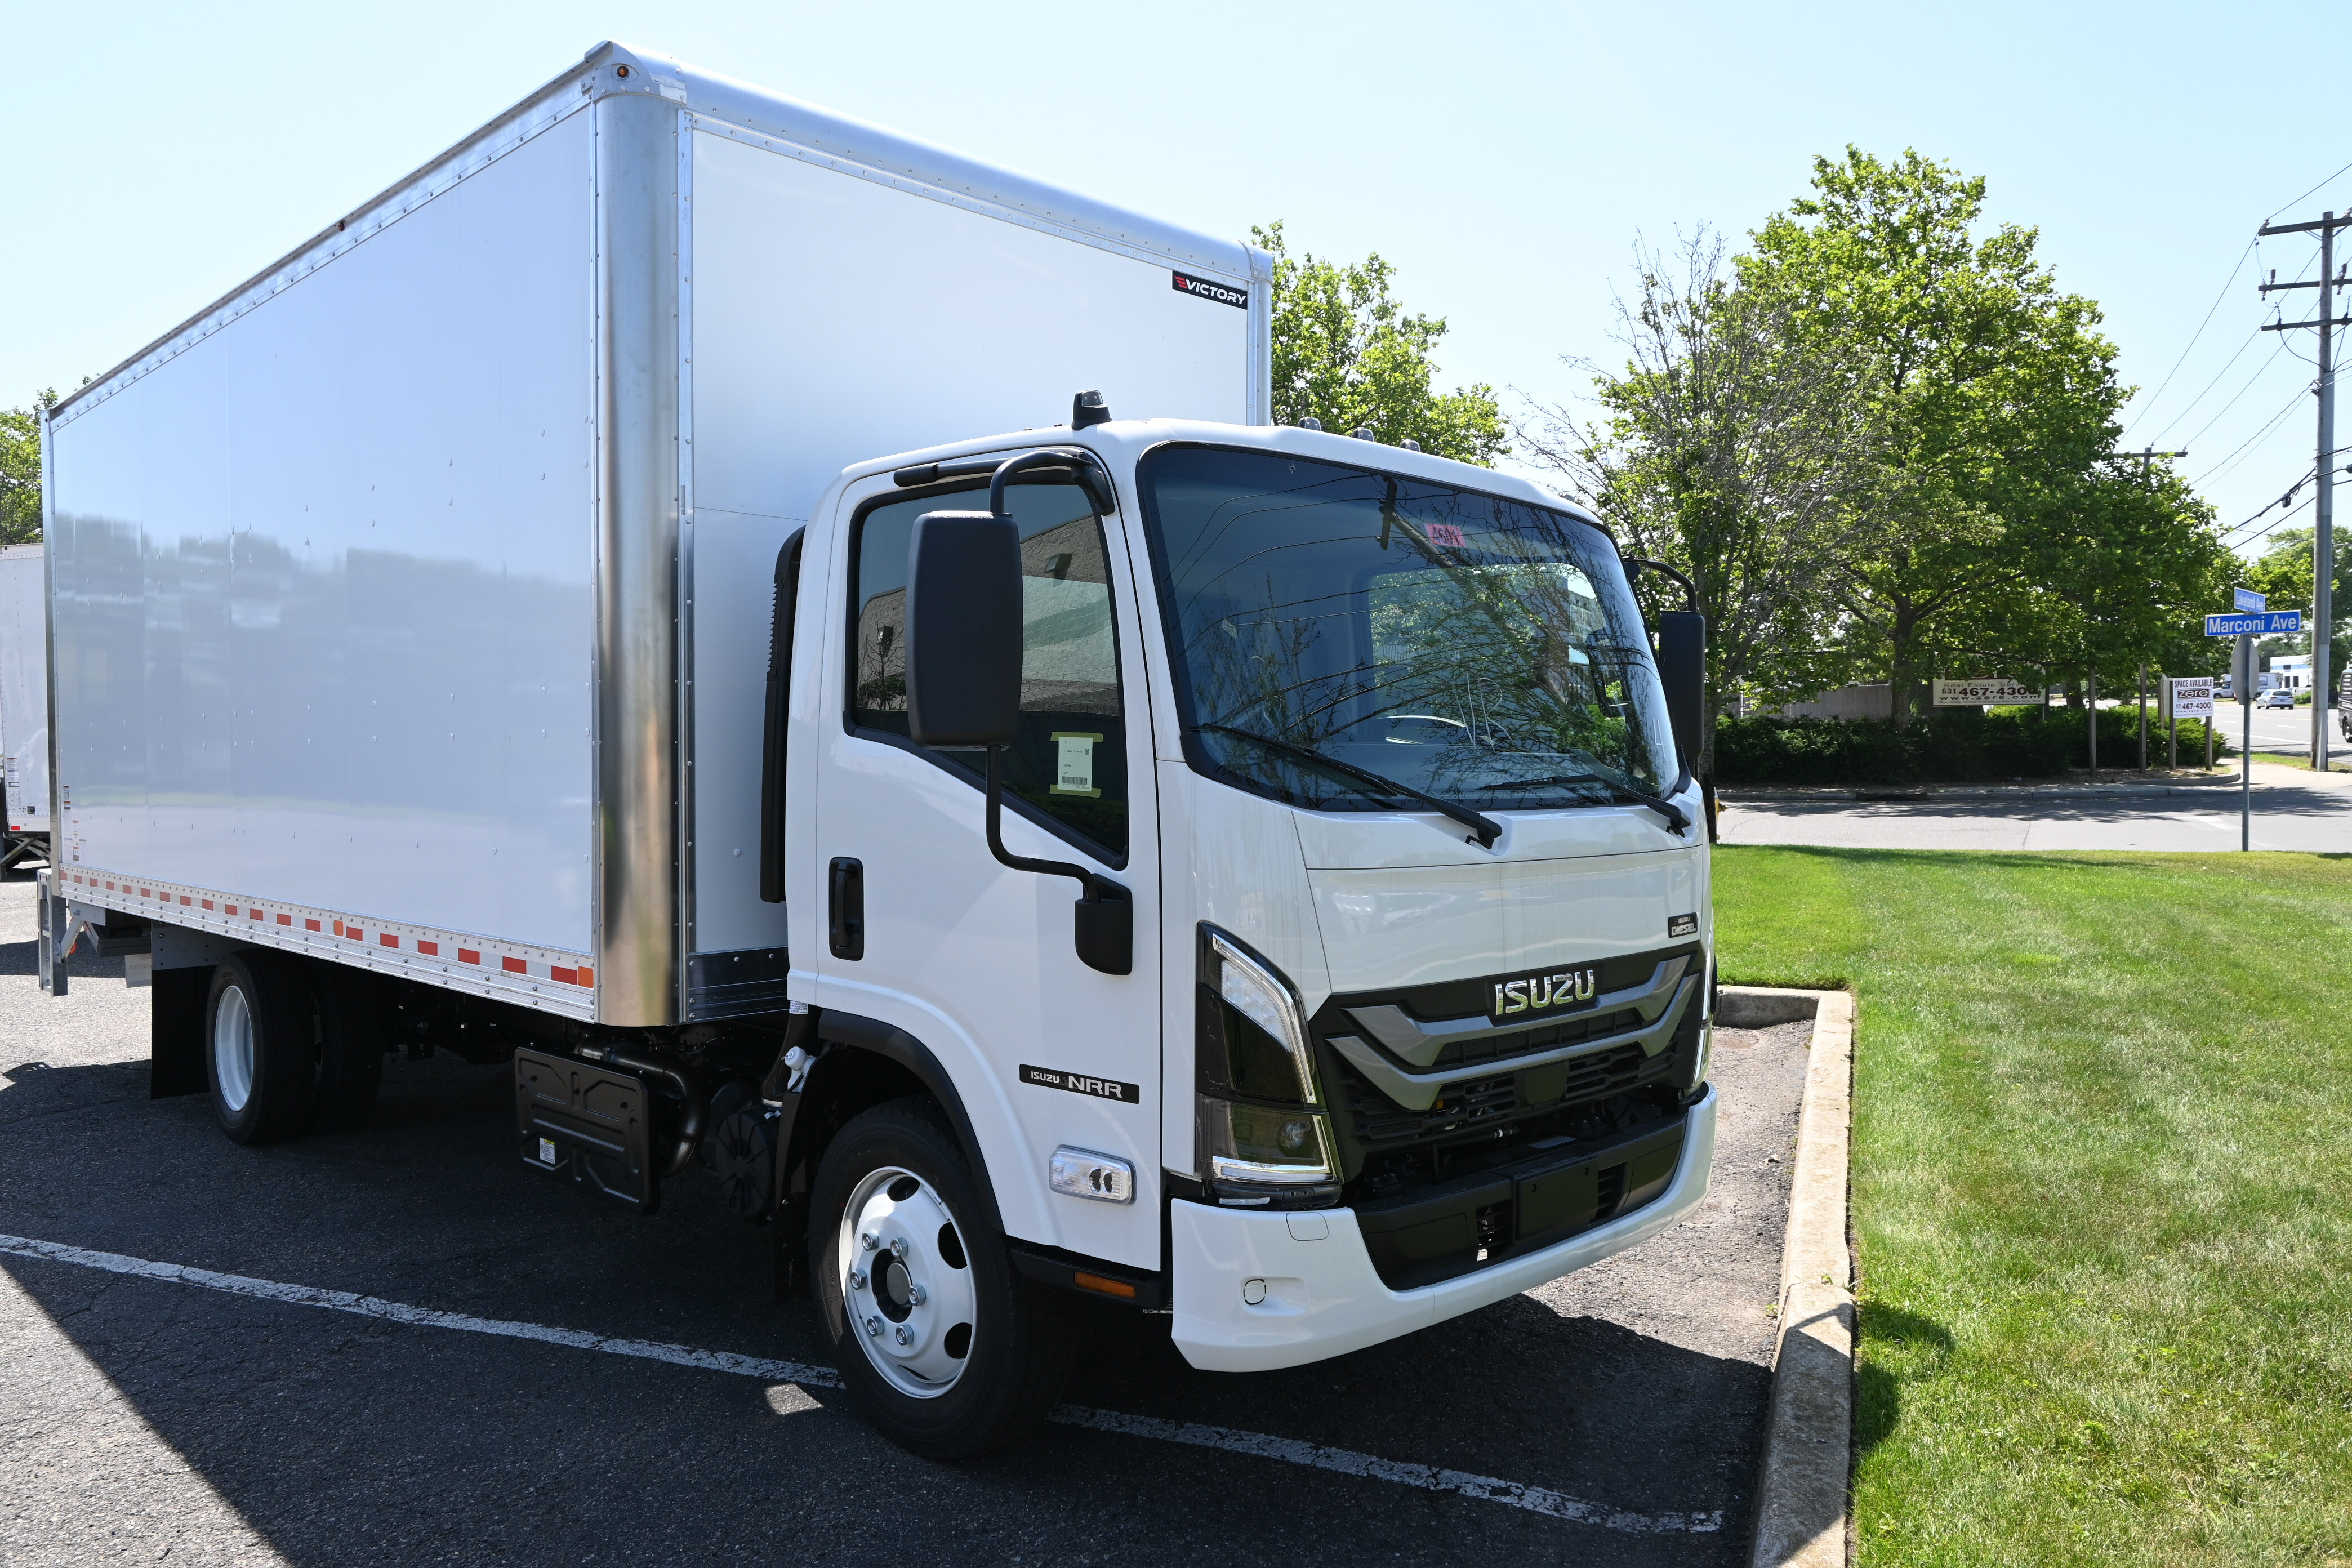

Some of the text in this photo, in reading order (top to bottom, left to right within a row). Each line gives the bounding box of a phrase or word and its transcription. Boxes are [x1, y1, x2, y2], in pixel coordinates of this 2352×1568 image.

[1185, 279, 1246, 304] VICTORY
[2236, 592, 2255, 608] Lakeland
[2208, 614, 2297, 633] Marconi Ave
[1671, 923, 1697, 936] DIESEL
[1495, 969, 1594, 1015] ISUZU
[1031, 1071, 1122, 1098] ISUZU NRR
